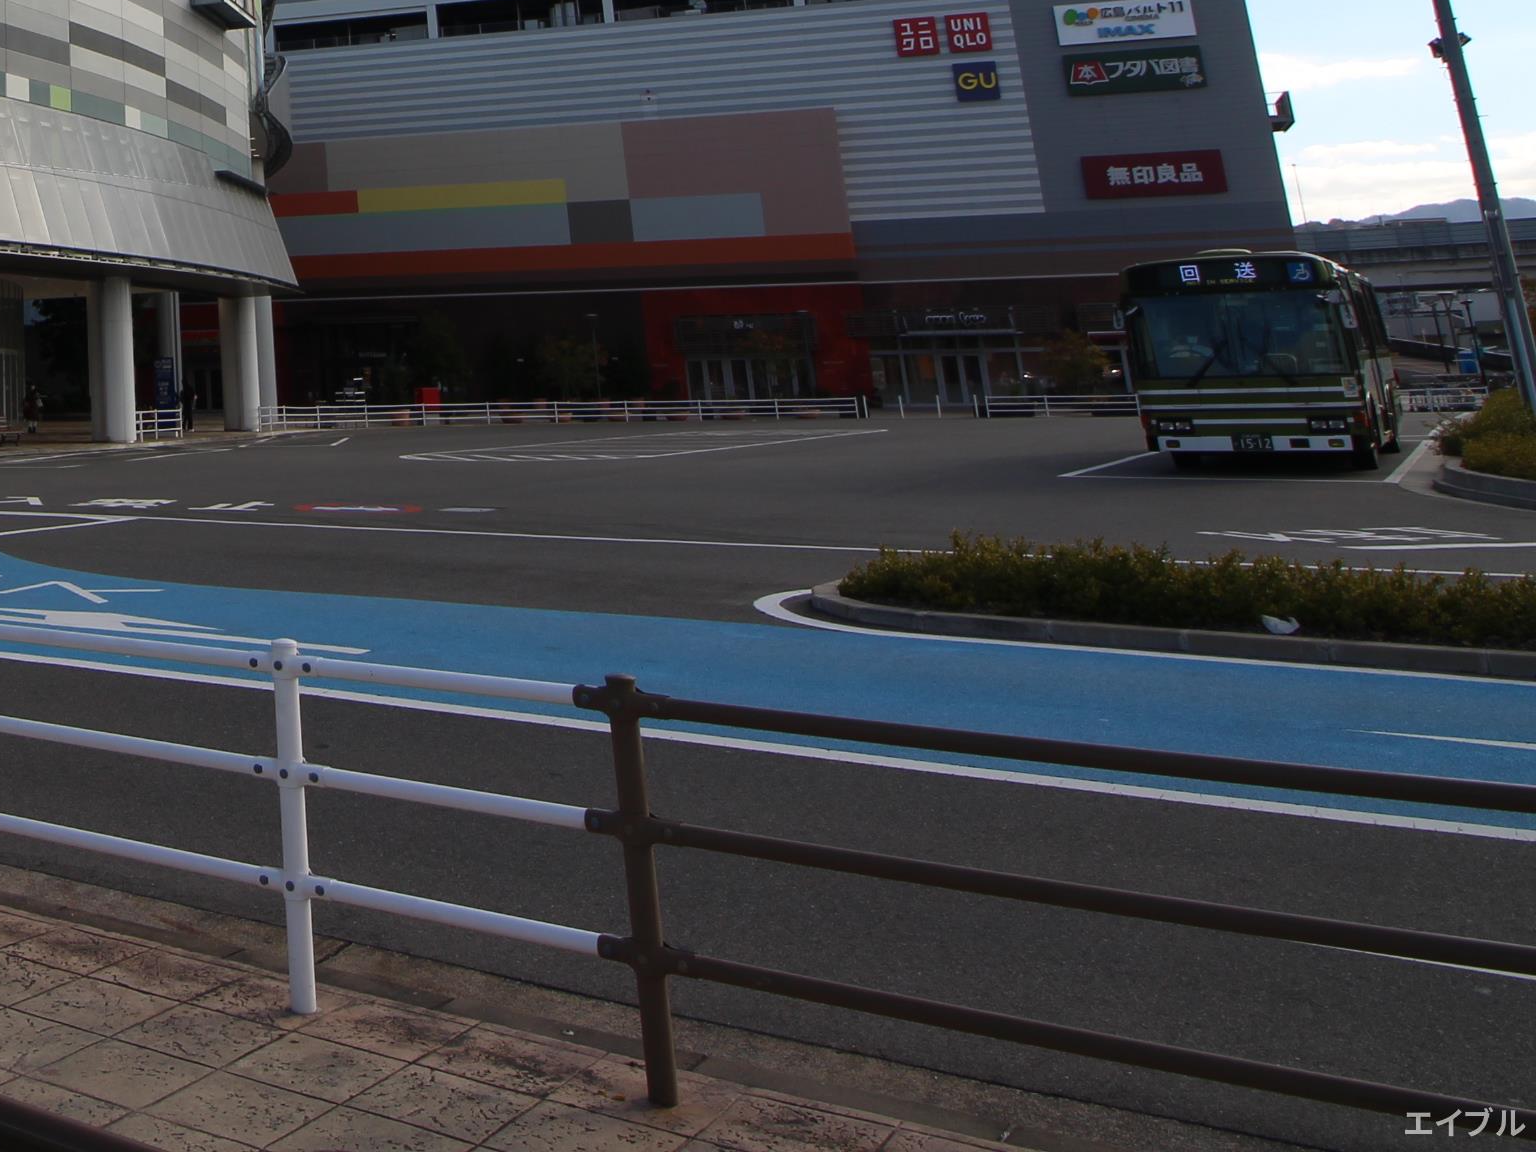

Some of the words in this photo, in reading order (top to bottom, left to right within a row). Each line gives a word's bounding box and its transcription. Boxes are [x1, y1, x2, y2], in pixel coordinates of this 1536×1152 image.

[900, 21, 932, 36] ユニ
[950, 16, 982, 32] UNI
[1097, 23, 1156, 39] IMAX
[902, 36, 935, 51] クロ
[953, 32, 987, 49] QLO
[1104, 56, 1200, 79] フタバ図書
[958, 71, 997, 90] GU
[1107, 162, 1204, 186] 無印良品
[1179, 261, 1257, 282] 回送
